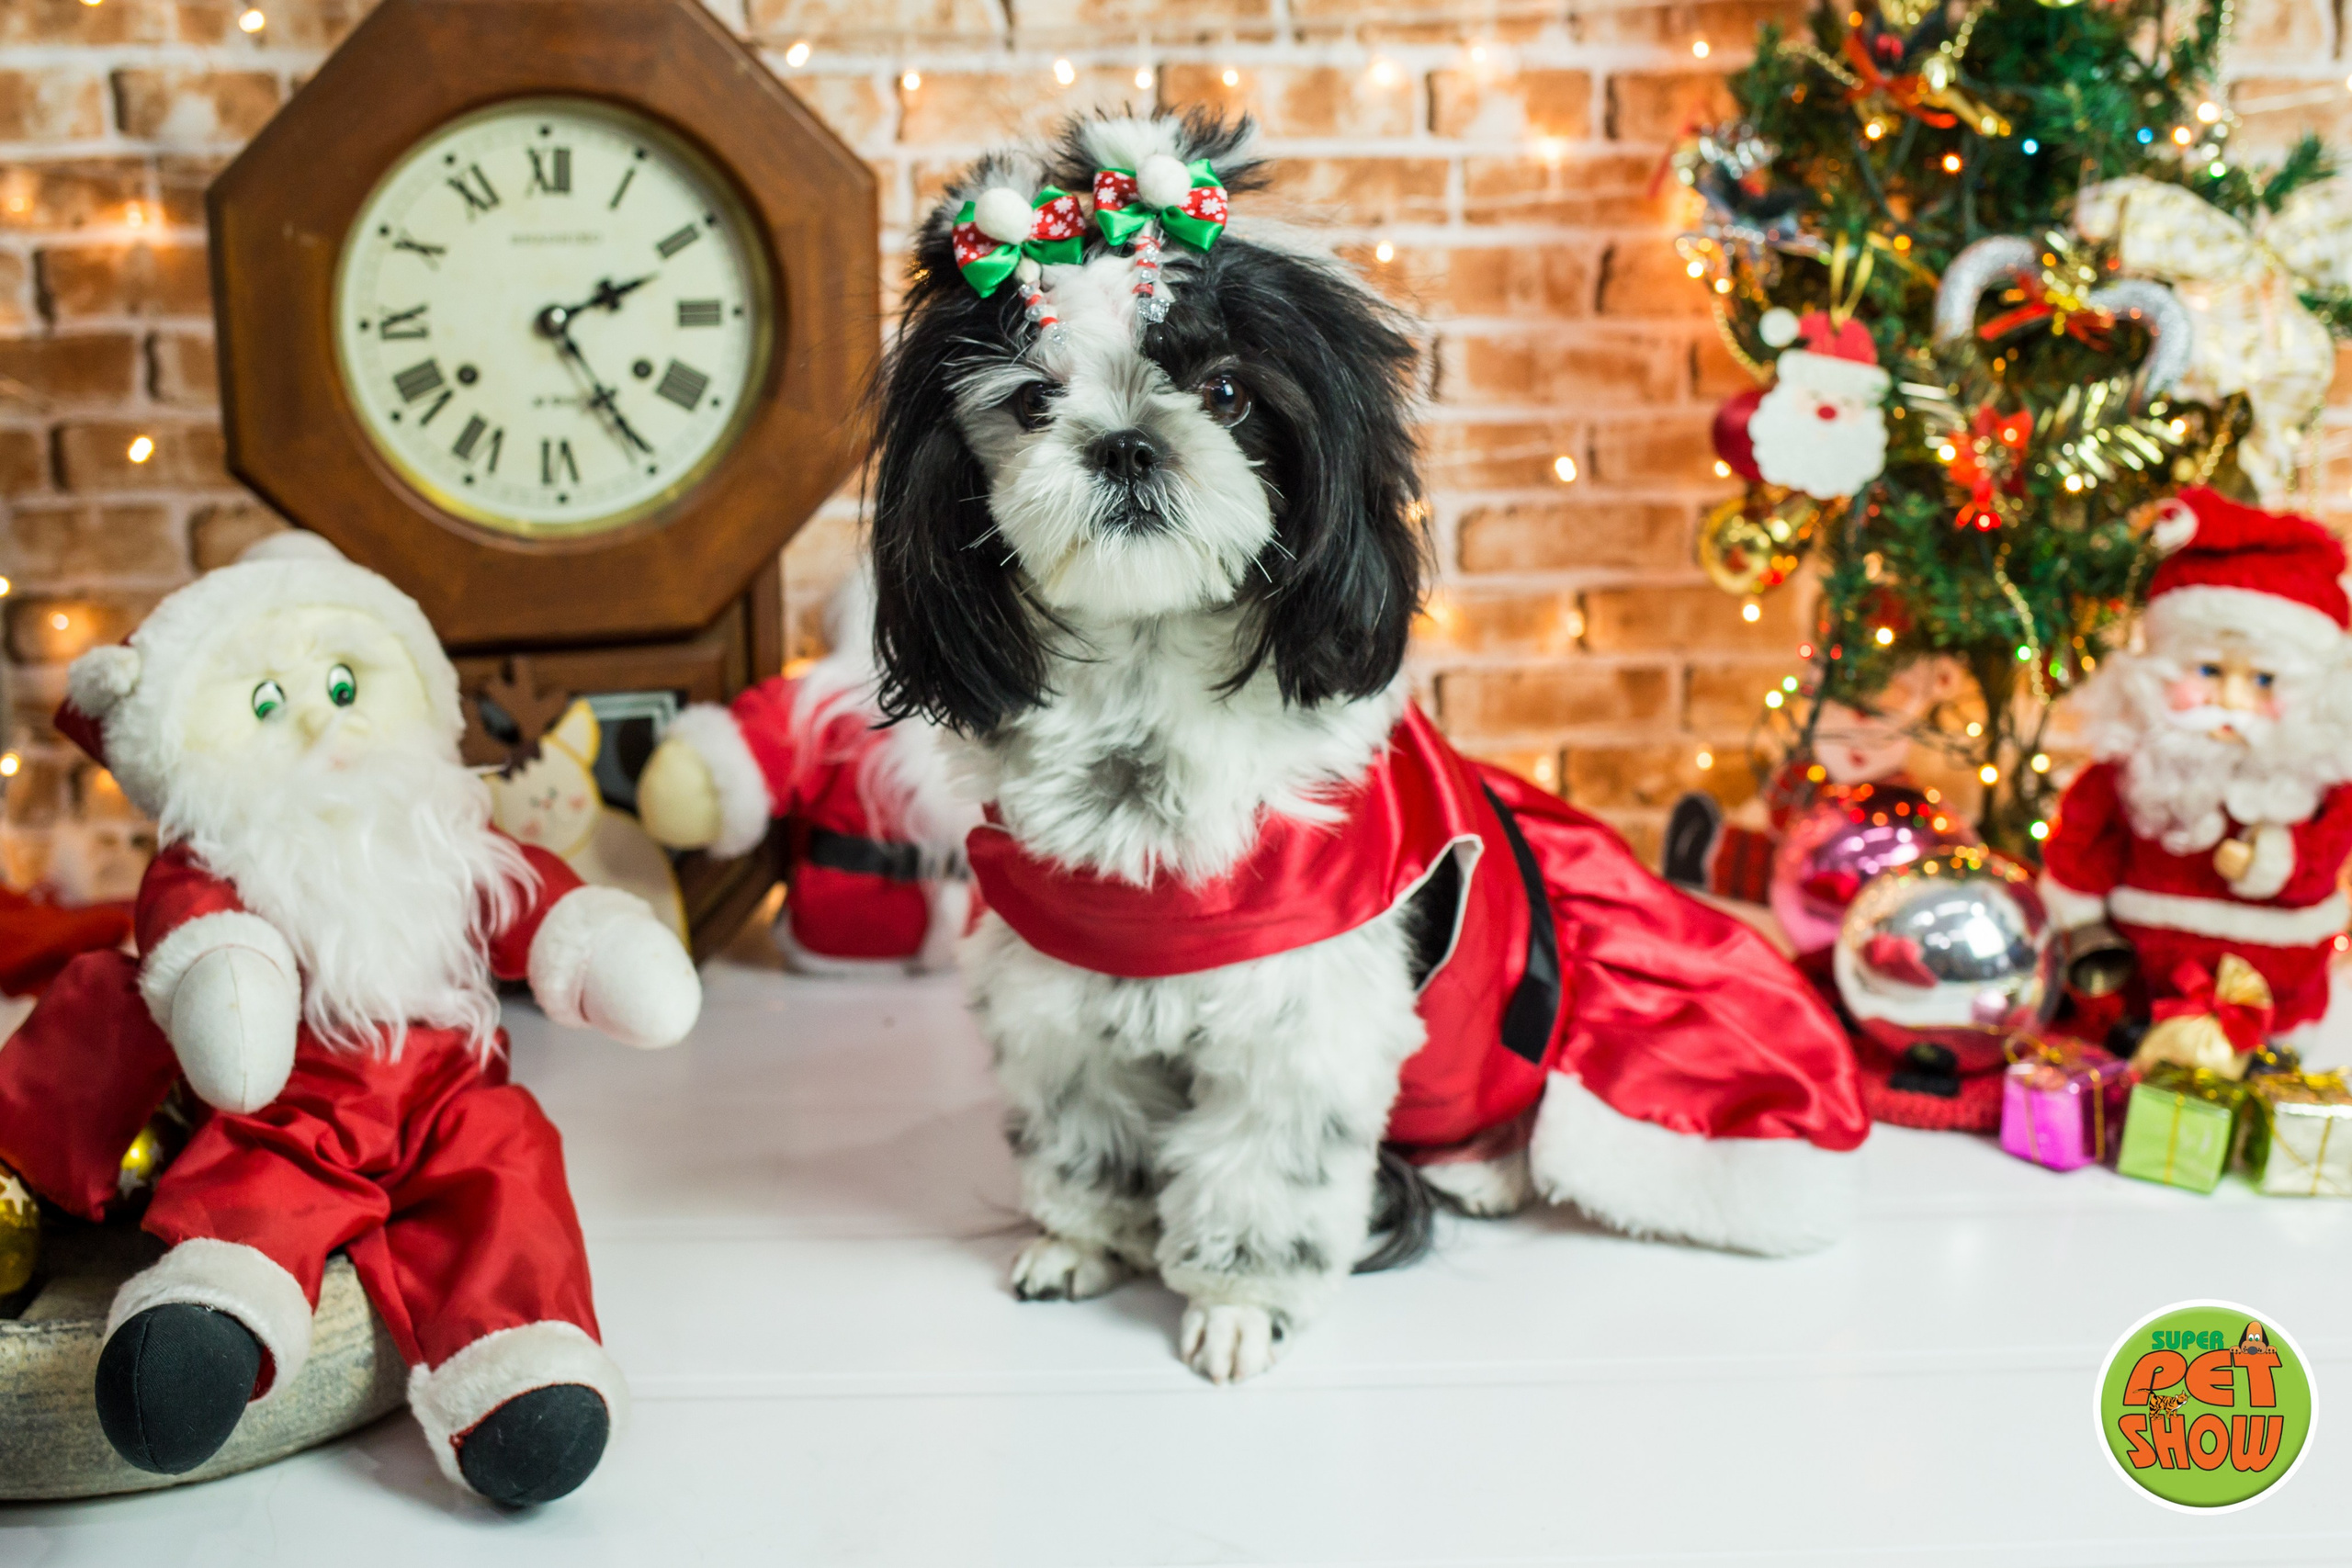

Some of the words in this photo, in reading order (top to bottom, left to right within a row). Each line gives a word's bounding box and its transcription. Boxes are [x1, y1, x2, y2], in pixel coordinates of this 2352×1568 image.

[447, 164, 499, 221] XI
[526, 148, 571, 197] XII
[393, 227, 446, 271] X
[657, 223, 699, 260] II
[379, 304, 428, 340] IX
[678, 299, 722, 327] III
[393, 359, 453, 426] VIII
[453, 415, 503, 473] VII
[542, 438, 580, 484] VI
